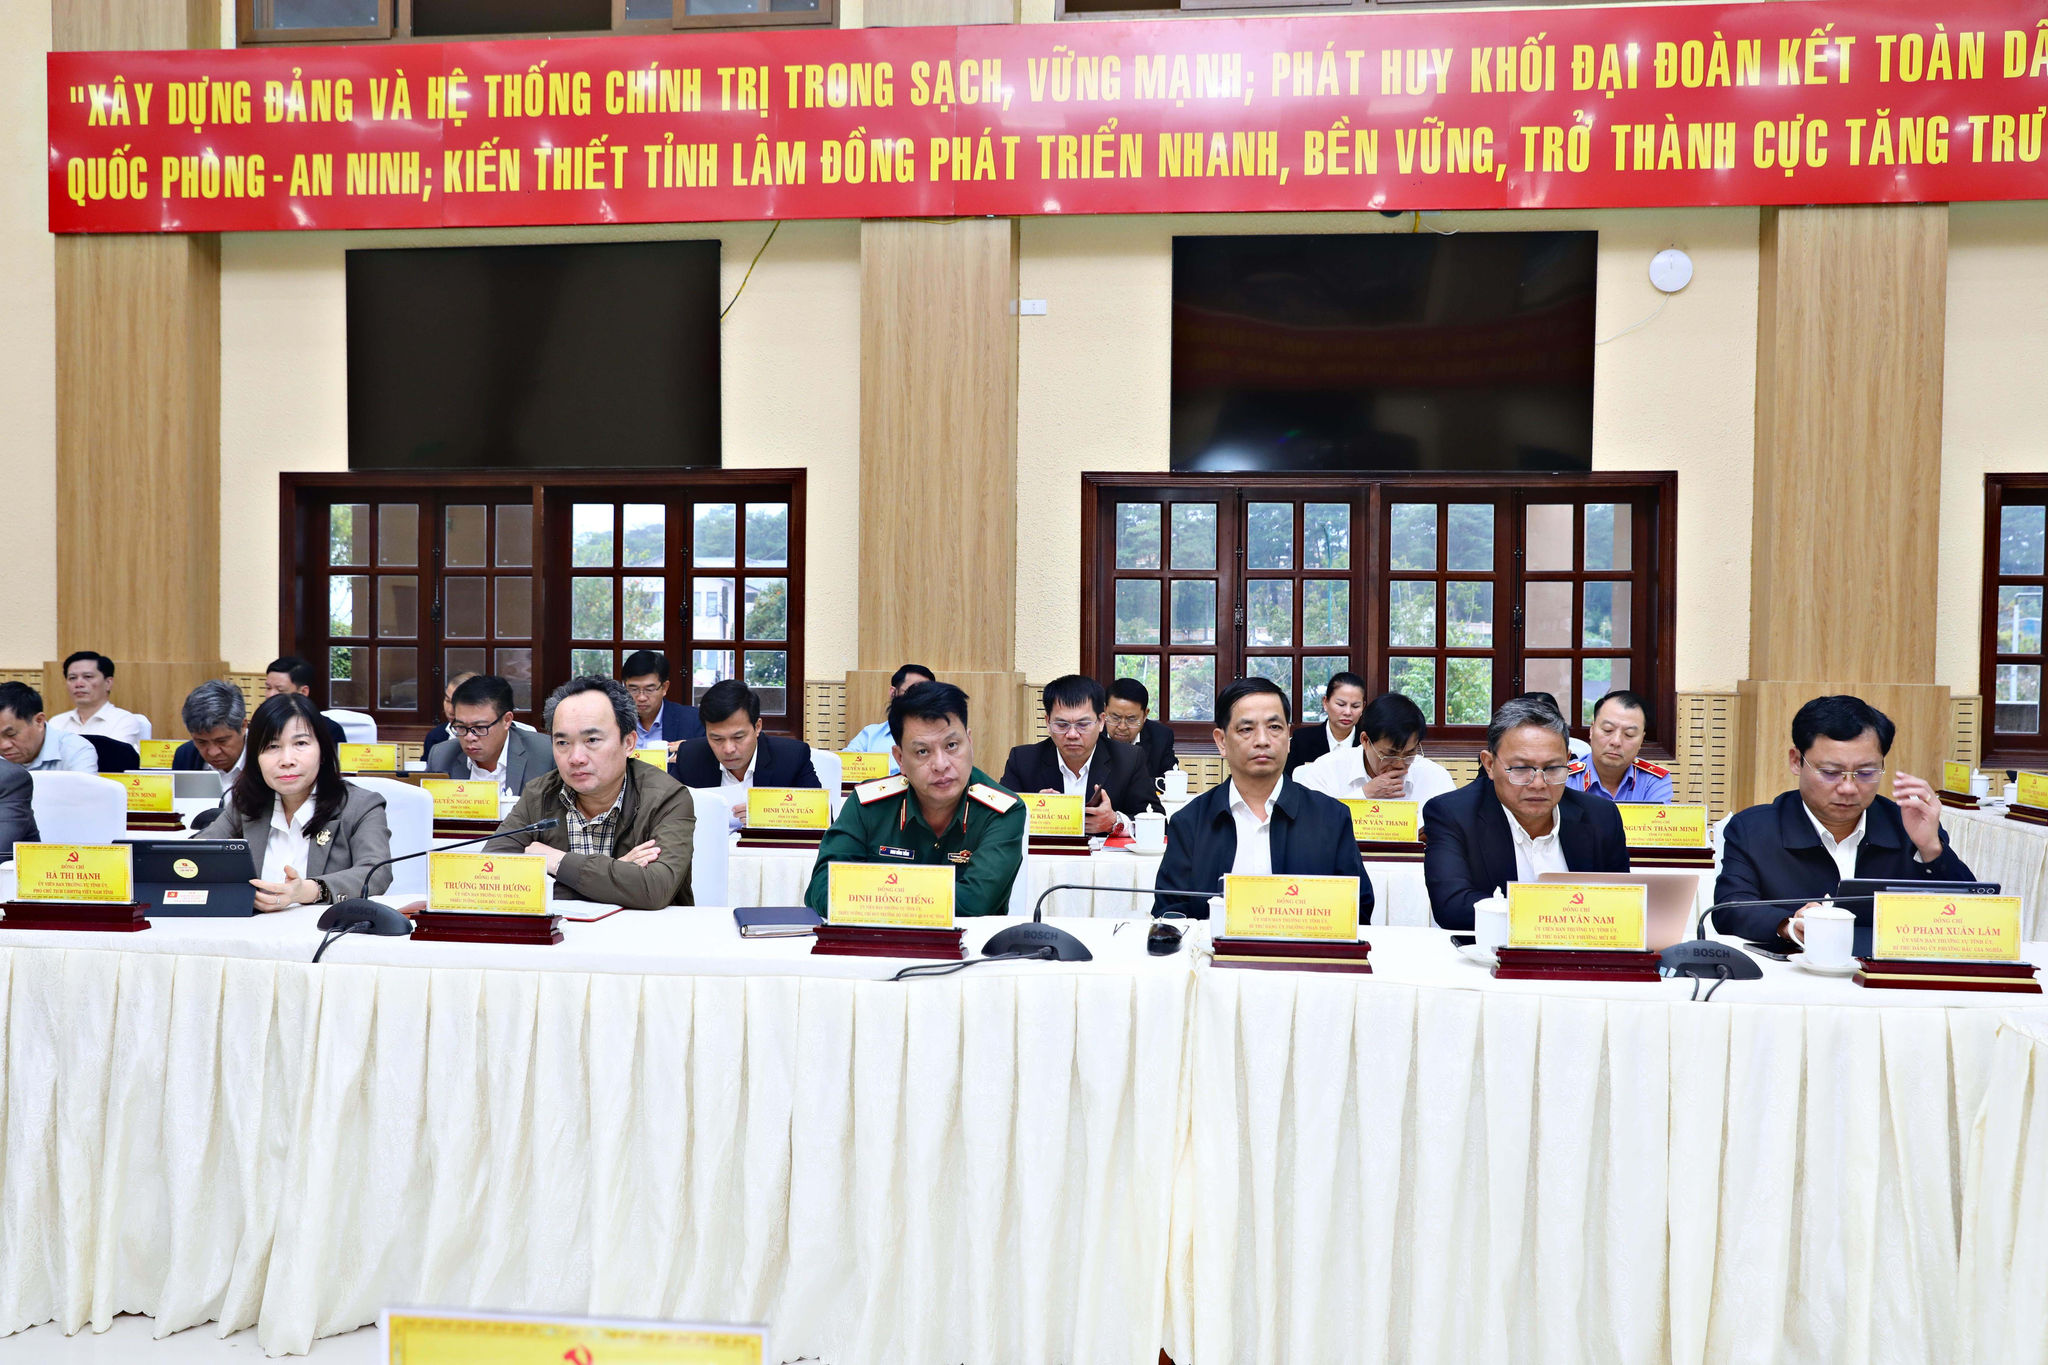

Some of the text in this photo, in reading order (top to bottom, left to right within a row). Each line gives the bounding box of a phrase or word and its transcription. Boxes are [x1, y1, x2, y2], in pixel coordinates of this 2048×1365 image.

[71, 75, 153, 126] "XÂY
[169, 76, 250, 133] DỰNG
[264, 67, 352, 122] ĐẢNG
[370, 69, 412, 120] VÀ
[428, 68, 468, 126] HỆ
[484, 60, 590, 117] THỐNG
[606, 61, 701, 114] CHÍNH
[718, 66, 768, 118] TRỊ
[784, 62, 893, 108] TRONG
[911, 59, 1013, 112] SẠCH,
[1028, 45, 1121, 103] VỮNG
[1135, 52, 1254, 108] MẠNH;
[1271, 44, 1366, 99] PHÁT
[1382, 49, 1452, 94] HUY
[1471, 32, 1555, 93] KHỐI
[1572, 44, 1637, 99] ĐẠI
[1654, 31, 1761, 88] ĐOÀN
[1779, 23, 1856, 84] KẾT
[1876, 23, 1985, 82] TOÀN
[68, 144, 147, 206] QUỐC
[347, 152, 432, 202] NINH;
[444, 137, 520, 192] KIẾN
[534, 134, 628, 190] THIẾT
[644, 132, 717, 188] TỈNH
[733, 134, 805, 186] LÂM
[820, 126, 914, 184] ĐỒNG
[930, 128, 1020, 181] PHÁT
[1037, 118, 1142, 179] TRIỂN
[1159, 131, 1289, 185] NHANH,
[1304, 116, 1378, 175] BỀN
[1395, 117, 1506, 182] VỮNG,
[1520, 110, 1592, 172] TRỞ
[1611, 114, 1736, 170] THÀNH
[1754, 114, 1827, 177] CỰC
[1846, 108, 1949, 165] TĂNG
[1968, 106, 2046, 162] TRƯ
[46, 870, 101, 881] HÀ THỊ HẠNH
[444, 881, 477, 890] TRƯƠNG
[480, 883, 500, 891] MINH
[1268, 907, 1303, 915] THANH
[1538, 914, 1615, 925] PHẠM VĂN NAM
[1024, 930, 1059, 940] BOSCH
[1946, 925, 1975, 935] XUÂN
[1978, 926, 2001, 936] LÂM
[1693, 948, 1730, 958] BOSCH
